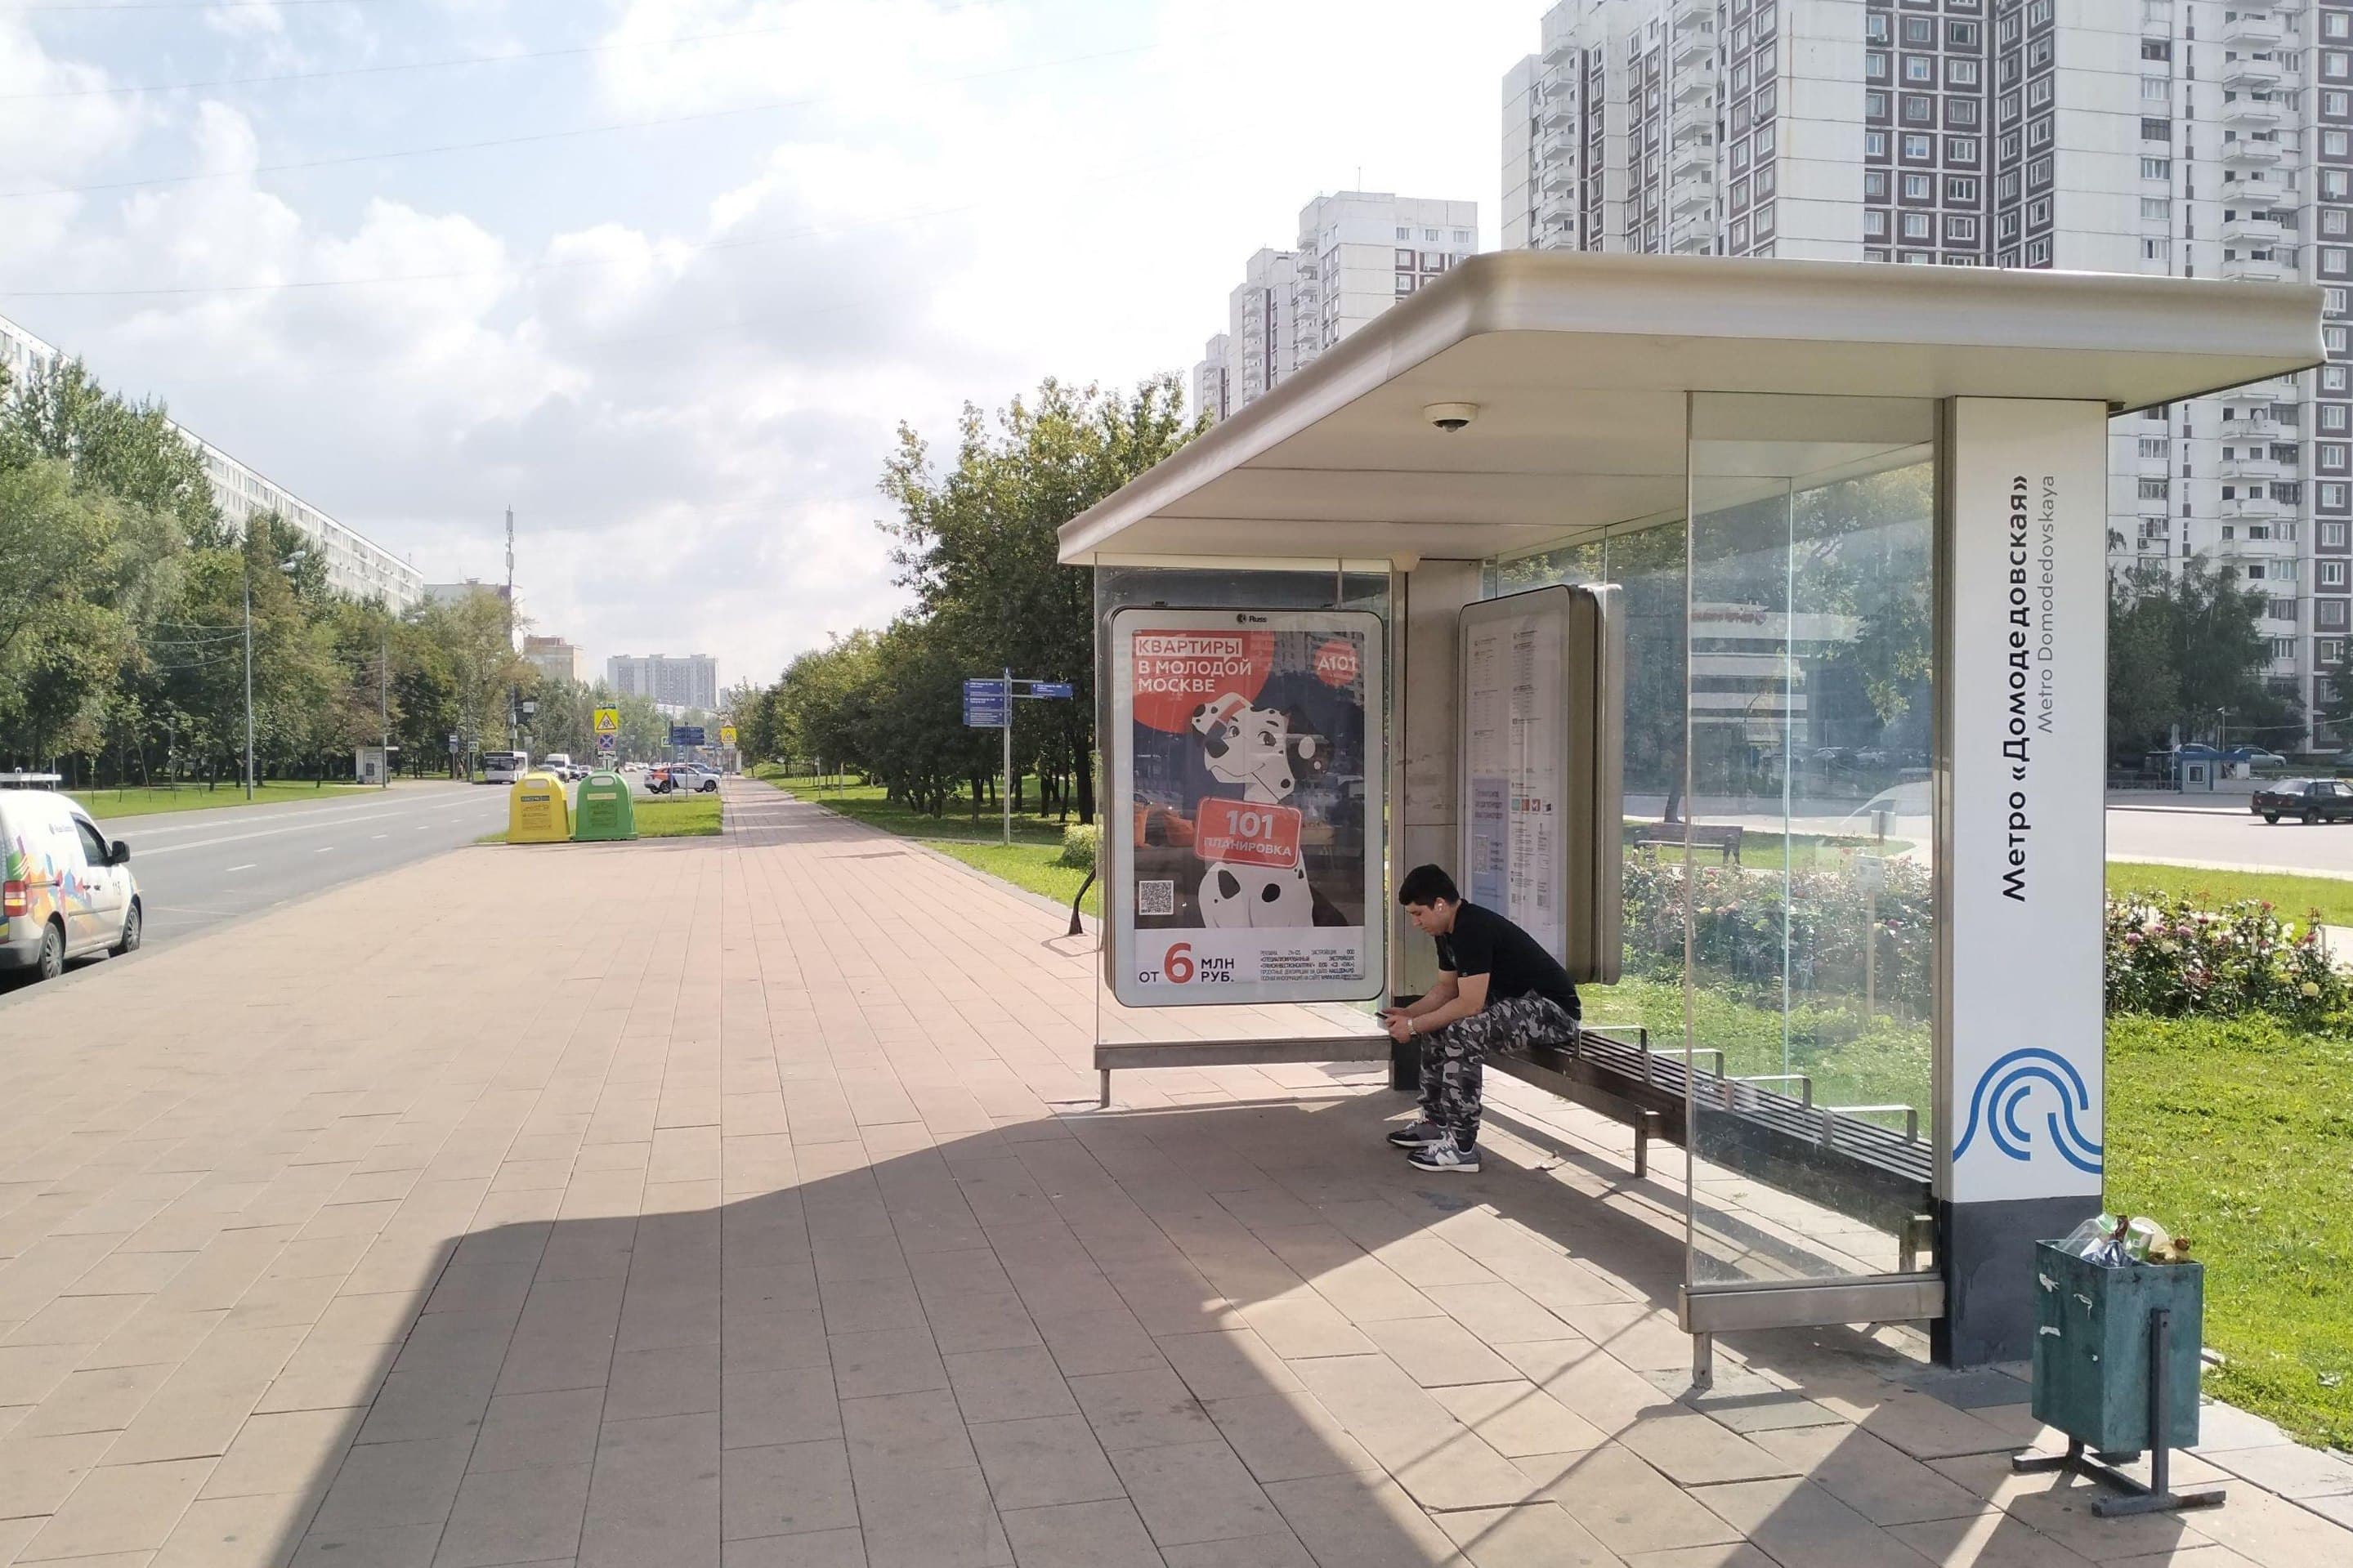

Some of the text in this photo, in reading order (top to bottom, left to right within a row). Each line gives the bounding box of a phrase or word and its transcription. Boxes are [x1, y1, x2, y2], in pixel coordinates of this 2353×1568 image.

[2038, 476, 2058, 734] Metro Domodedovskaya
[1138, 640, 1240, 654] КВАРТИРЫ
[1138, 658, 1252, 678] В МОЛОДОЙ
[1138, 678, 1215, 693] МОСКВЕ
[2002, 475, 2031, 902] Метро «Домодедовская»
[1226, 810, 1273, 839] 101
[1204, 837, 1291, 857] ПЛАНИРОВКА
[1139, 942, 1234, 984] ОТ 6 МЛН
[1201, 972, 1234, 982] РУБ.
